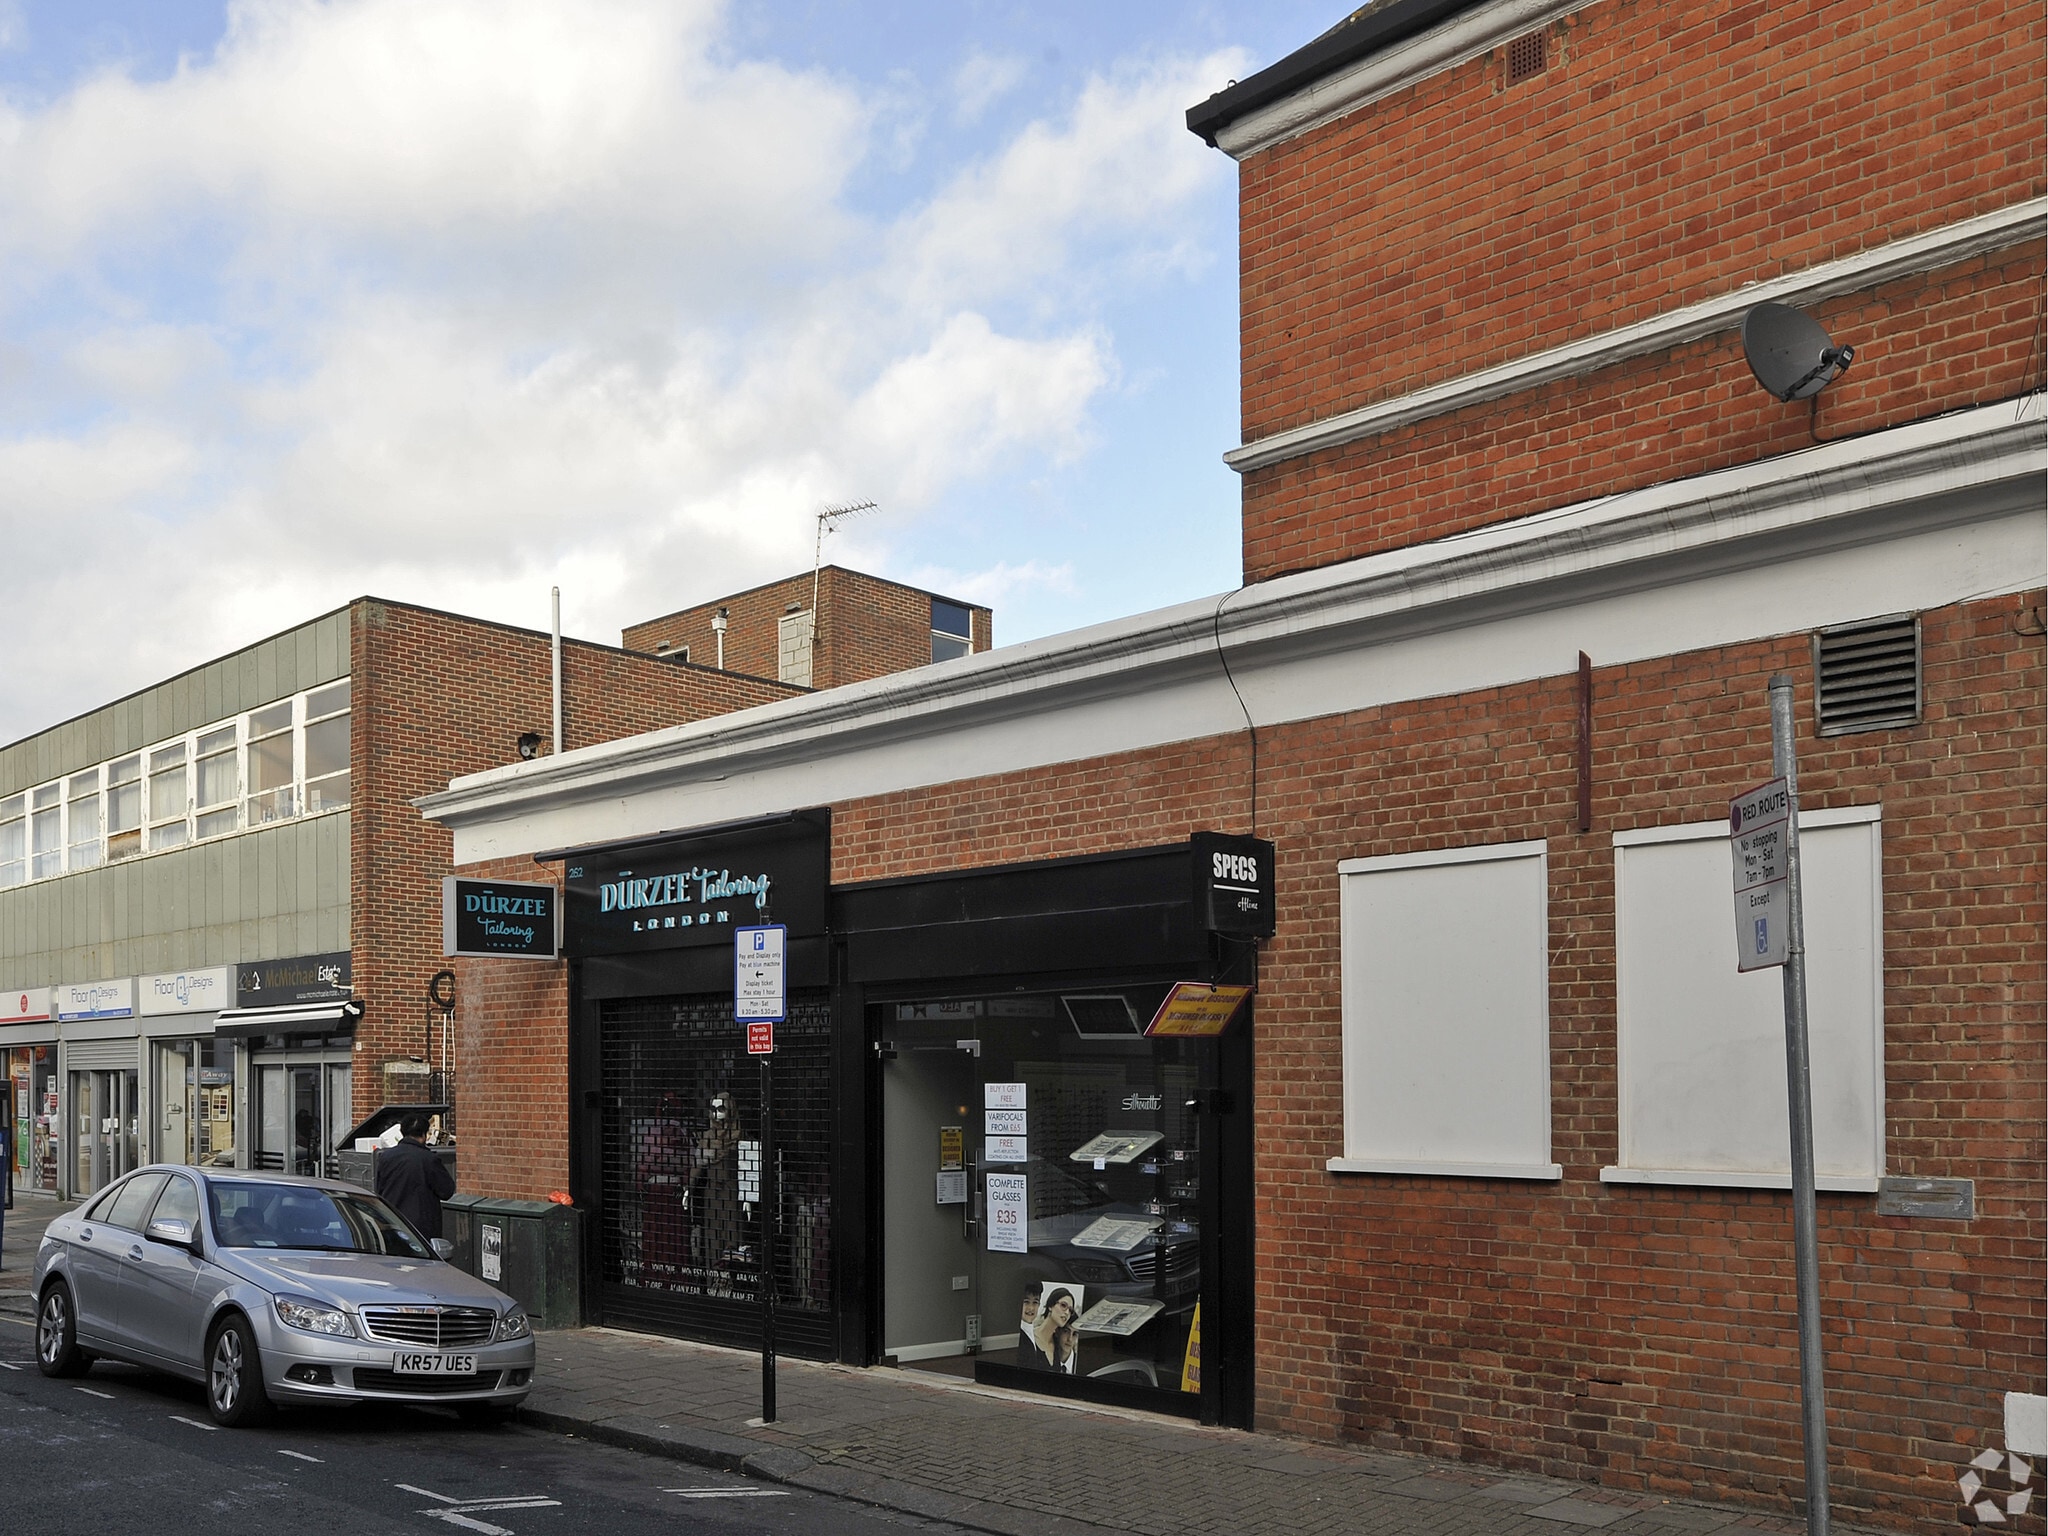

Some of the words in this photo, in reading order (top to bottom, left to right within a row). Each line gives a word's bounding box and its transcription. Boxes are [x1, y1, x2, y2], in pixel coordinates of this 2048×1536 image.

[1742, 802, 1757, 822] RED
[1759, 791, 1787, 817] ROUTE
[1741, 839, 1749, 853] No
[1752, 830, 1778, 850] stopping
[1745, 853, 1757, 868] Mon
[1763, 847, 1774, 862] Sat
[568, 867, 584, 879] 262
[1212, 852, 1257, 882] SPECS
[692, 866, 771, 910] Tailoring
[1750, 890, 1770, 908] Except
[633, 910, 730, 932] LONDON
[477, 916, 535, 944] Tailoring
[756, 952, 771, 960] Display
[772, 951, 781, 959] only
[189, 975, 214, 990] Designs
[745, 980, 760, 988] Display
[98, 986, 119, 999] Designs
[989, 1085, 1000, 1093] BUY
[1006, 1085, 1017, 1093] GET
[988, 1112, 1023, 1121] VARIFOCALS
[991, 1123, 1009, 1132] FROM
[1010, 1124, 1021, 1132] £65
[999, 1139, 1014, 1147] FREE
[988, 1178, 1024, 1189] COMPLETE
[992, 1191, 1021, 1202] GLASSES
[996, 1209, 1017, 1224] £35
[401, 1354, 442, 1370] KR57
[446, 1356, 472, 1371] UES
